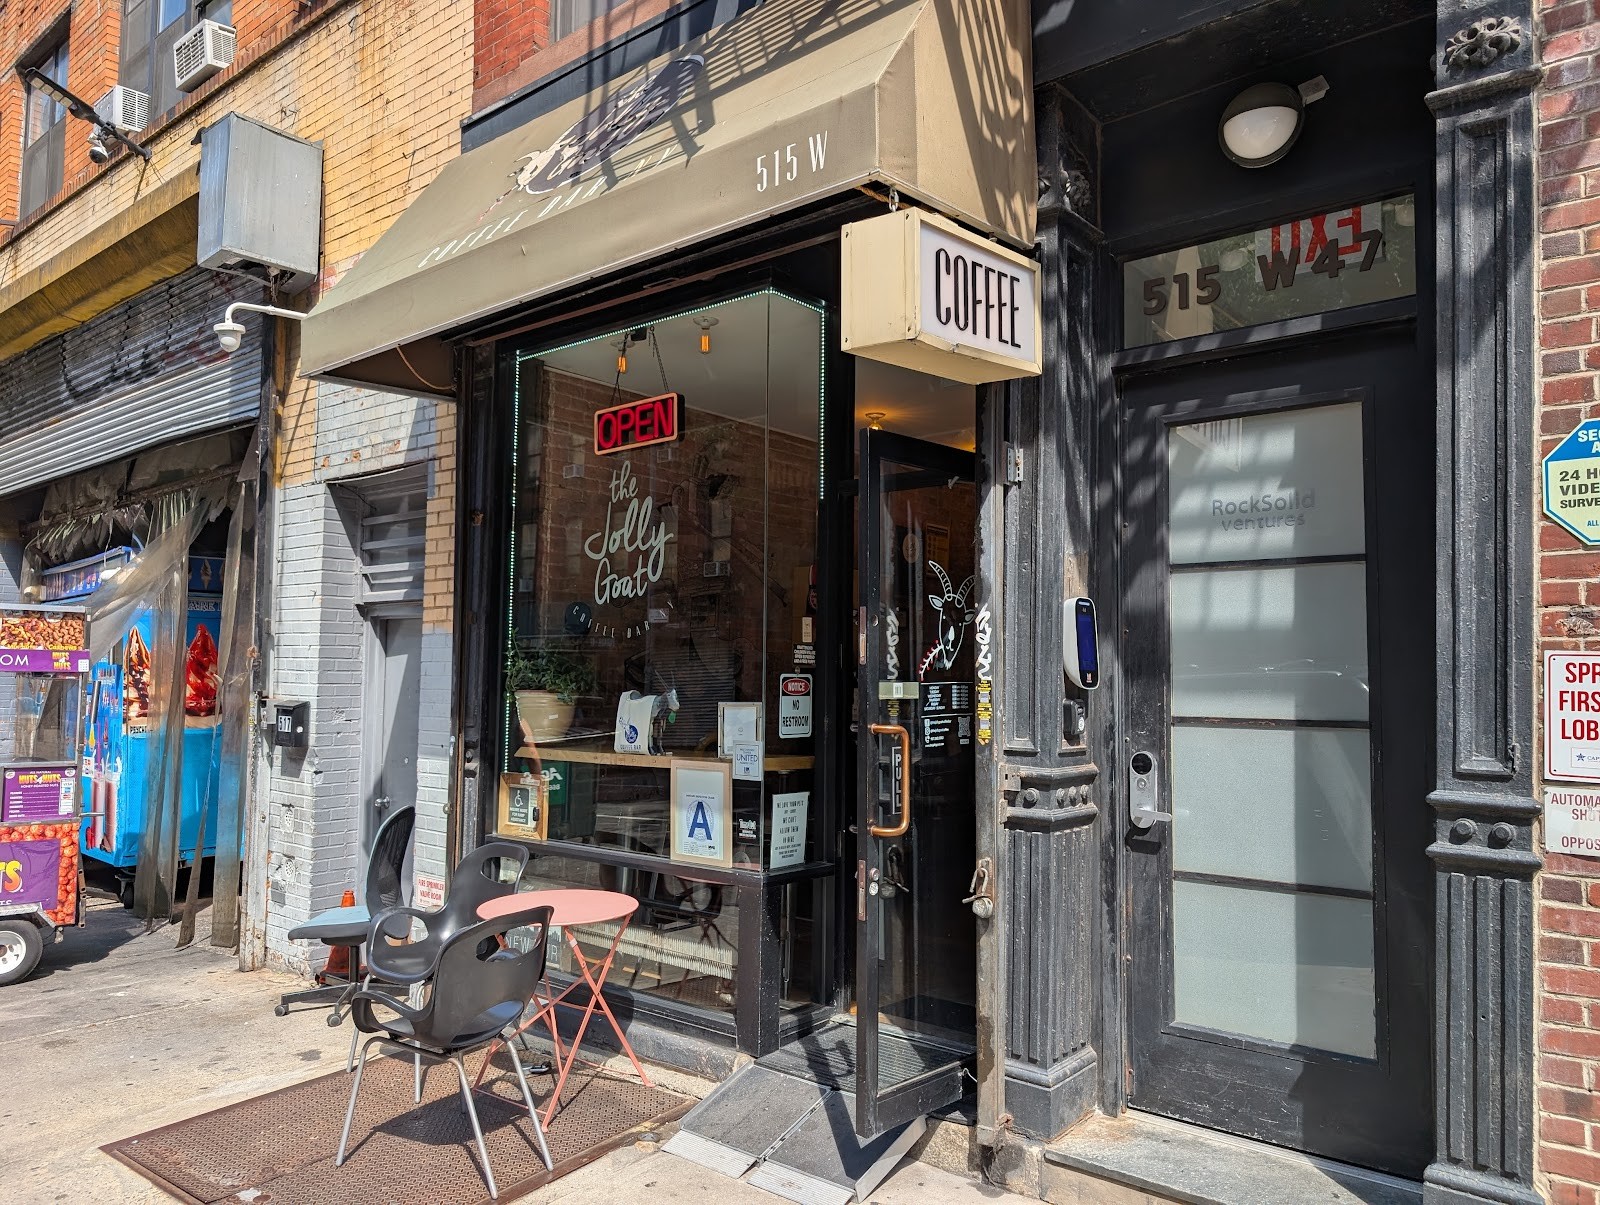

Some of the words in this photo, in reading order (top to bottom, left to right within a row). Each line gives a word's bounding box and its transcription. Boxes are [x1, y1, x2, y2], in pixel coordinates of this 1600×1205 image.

[756, 142, 798, 193] 515
[808, 130, 829, 172] W
[417, 209, 529, 268] COFFEE
[537, 175, 608, 219] BAR
[1142, 264, 1222, 317] 515
[1257, 247, 1301, 291] W
[1311, 229, 1383, 279] 47
[935, 247, 1021, 349] COFFEE
[599, 399, 673, 449] OPEN
[609, 460, 639, 503] the
[1559, 469, 1581, 482] 24
[1586, 467, 1600, 480] H
[1212, 488, 1316, 517] RockSolid
[1221, 514, 1306, 532] ventures
[584, 496, 674, 583] Jolly
[595, 554, 648, 605] Goat
[627, 620, 650, 639] BAR
[54, 662, 71, 670] NUTS
[1565, 662, 1600, 684] SPR
[787, 682, 805, 692] NOTICE
[792, 699, 800, 710] NO
[1559, 690, 1600, 712] FIRS
[279, 715, 291, 732] 517
[782, 715, 809, 727] RESTROOM
[736, 754, 758, 763] UNITED
[688, 801, 713, 841] A
